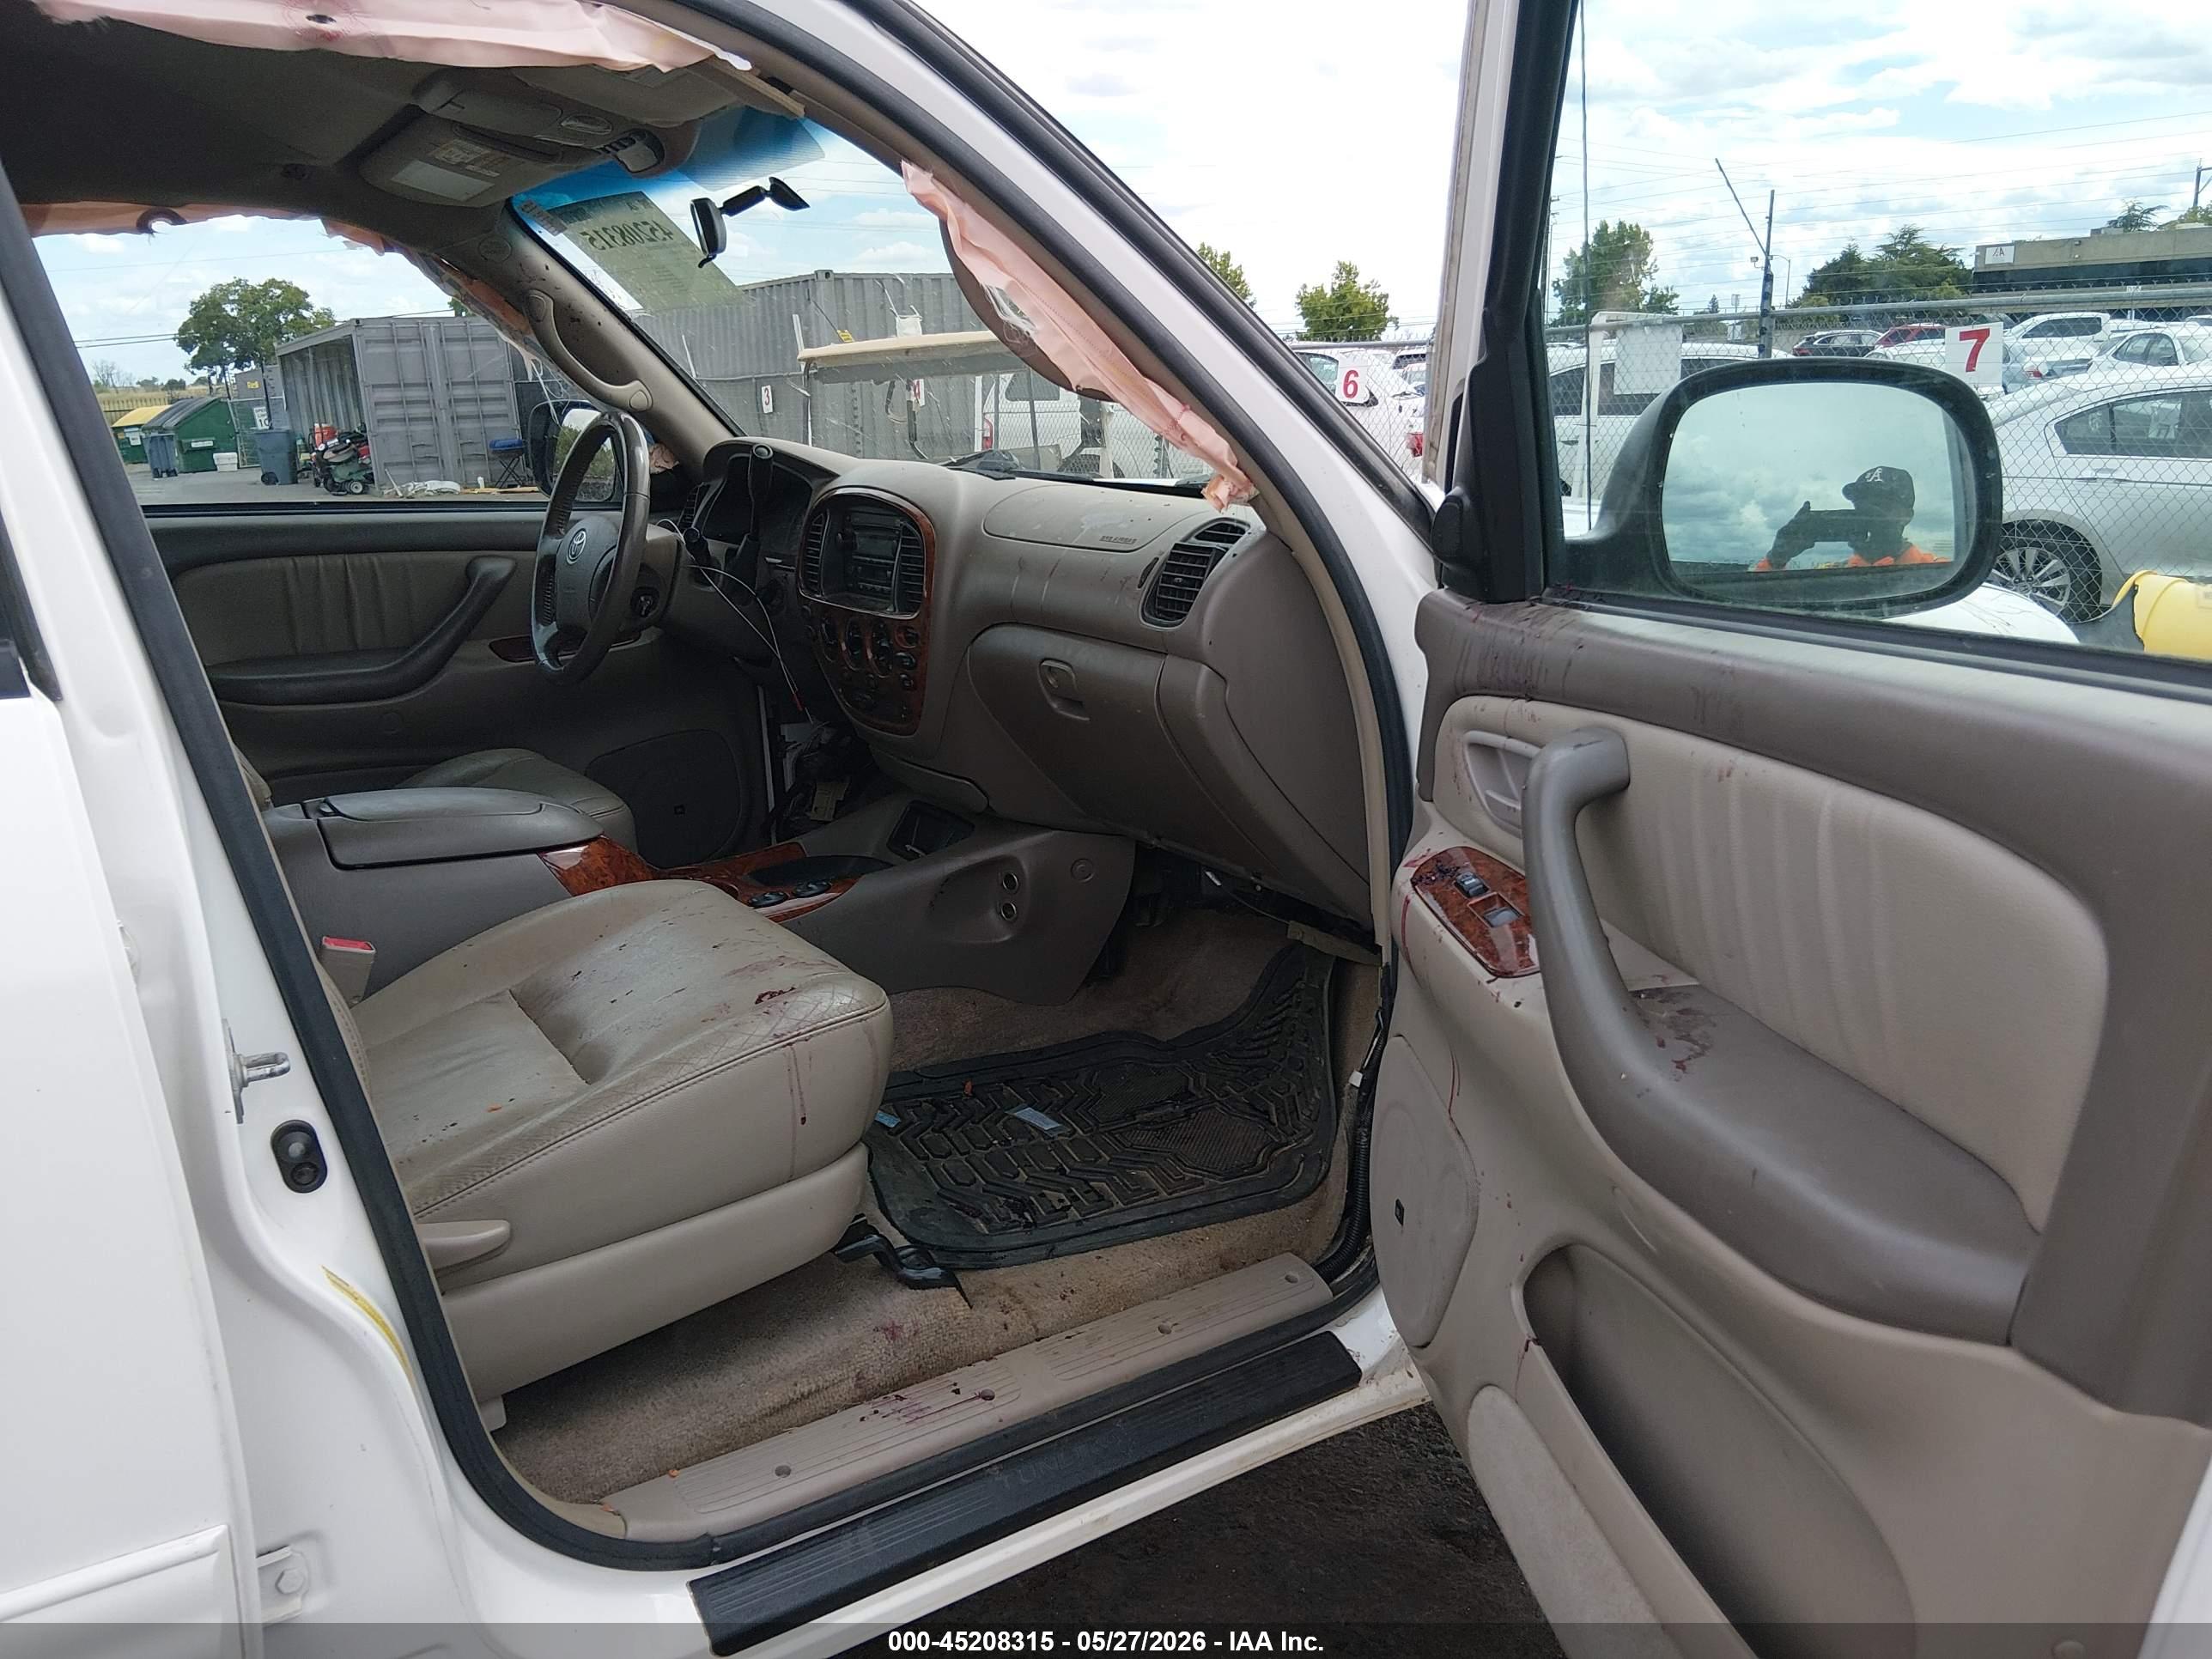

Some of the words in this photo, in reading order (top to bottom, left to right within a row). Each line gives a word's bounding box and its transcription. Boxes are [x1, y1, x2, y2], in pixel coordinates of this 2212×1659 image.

[1959, 328, 1990, 373] 7
[764, 387, 770, 406] 3
[1343, 369, 1359, 399] 6
